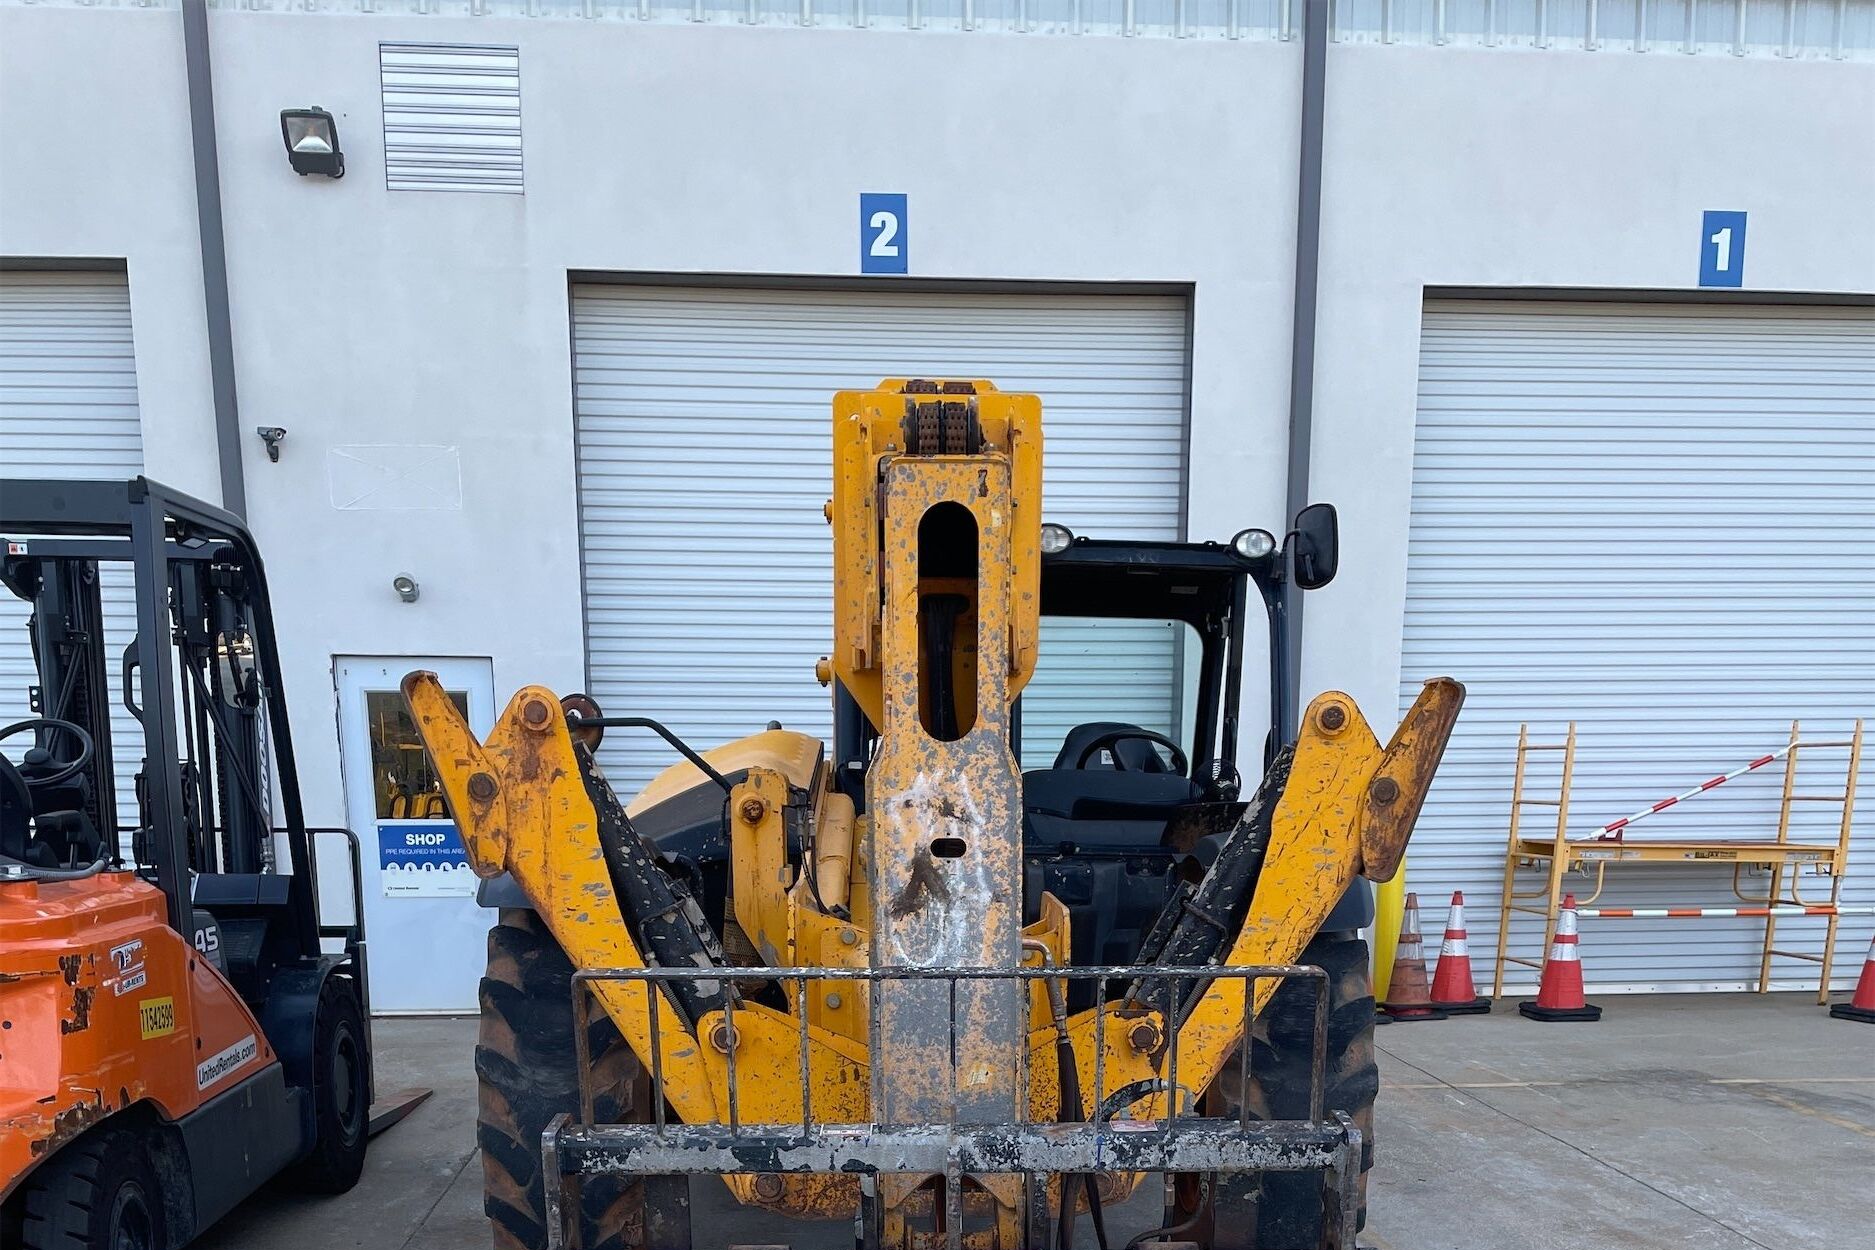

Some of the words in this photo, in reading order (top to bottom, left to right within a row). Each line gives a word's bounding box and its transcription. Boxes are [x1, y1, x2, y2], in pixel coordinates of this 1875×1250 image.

[870, 211, 898, 256] 2
[1711, 227, 1732, 271] 1
[405, 833, 446, 846] SHOP
[195, 926, 219, 953] 45
[141, 1003, 174, 1033] 11542599
[198, 1043, 256, 1086] UnitedRentals.com
